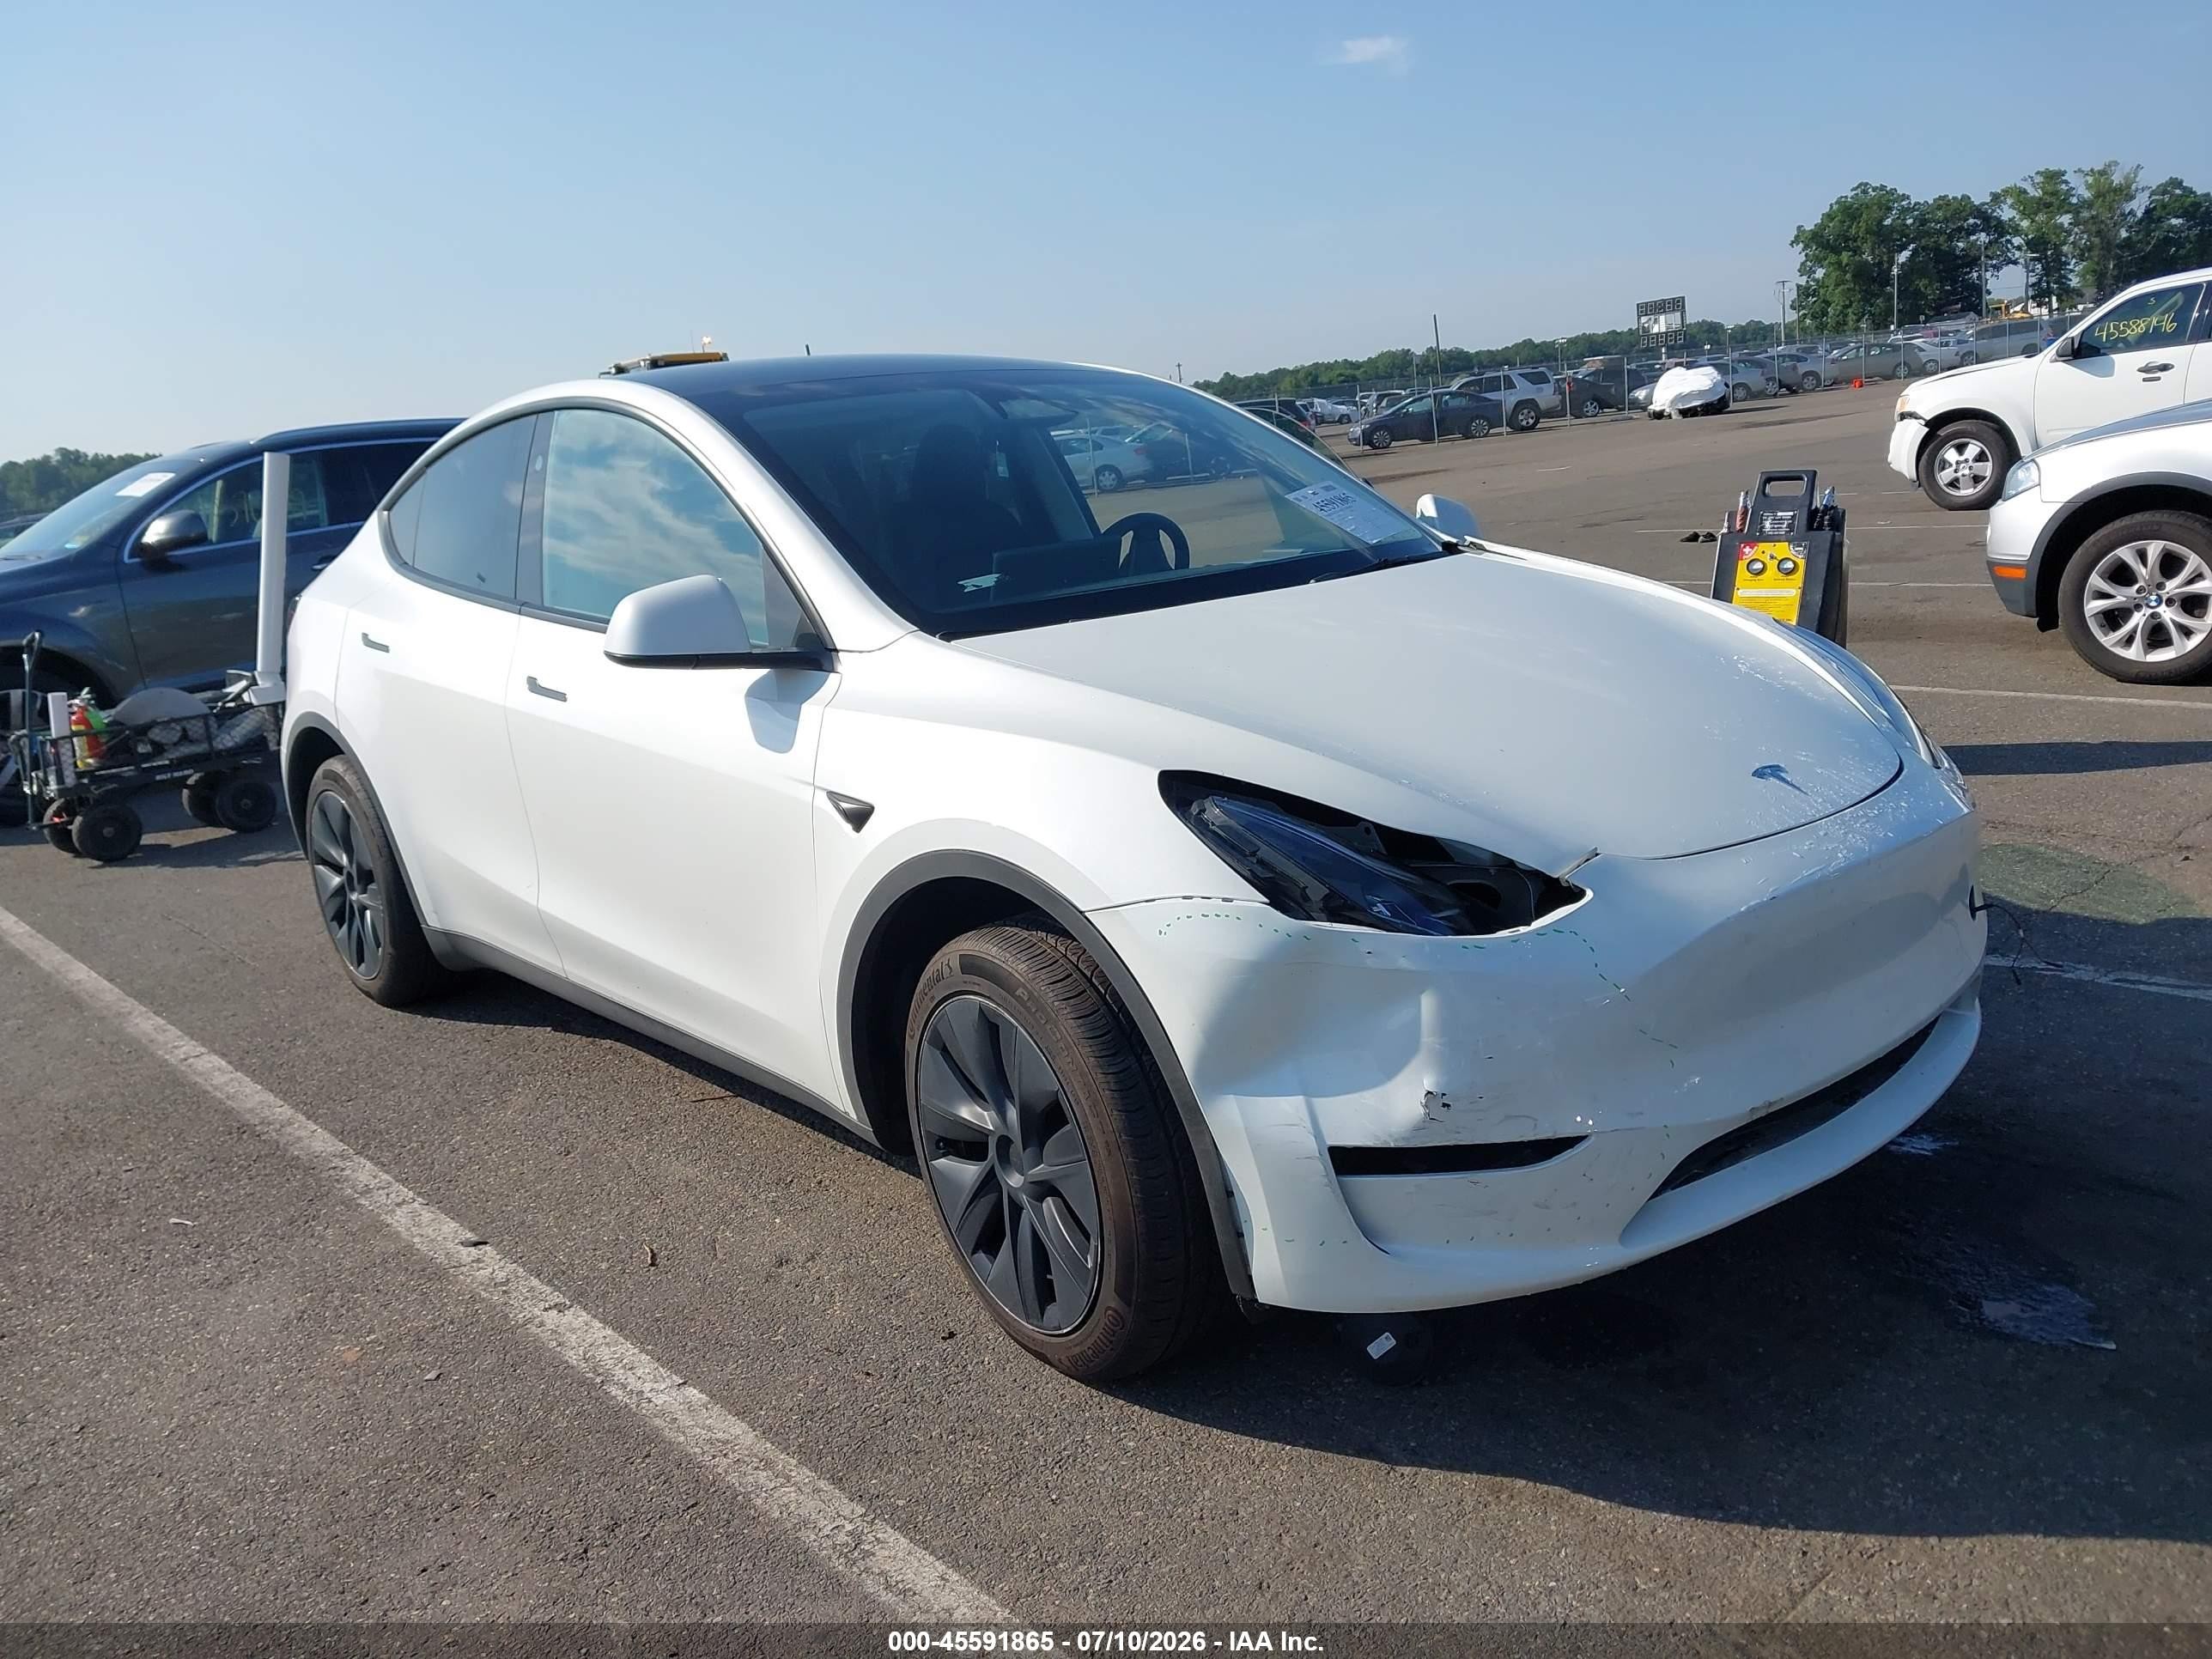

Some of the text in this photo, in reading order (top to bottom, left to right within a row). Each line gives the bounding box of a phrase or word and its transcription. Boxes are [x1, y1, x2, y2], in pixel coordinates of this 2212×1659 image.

[2094, 312, 2178, 343] 45588146
[1311, 492, 1357, 513] 45591865
[907, 961, 946, 1039] Continental
